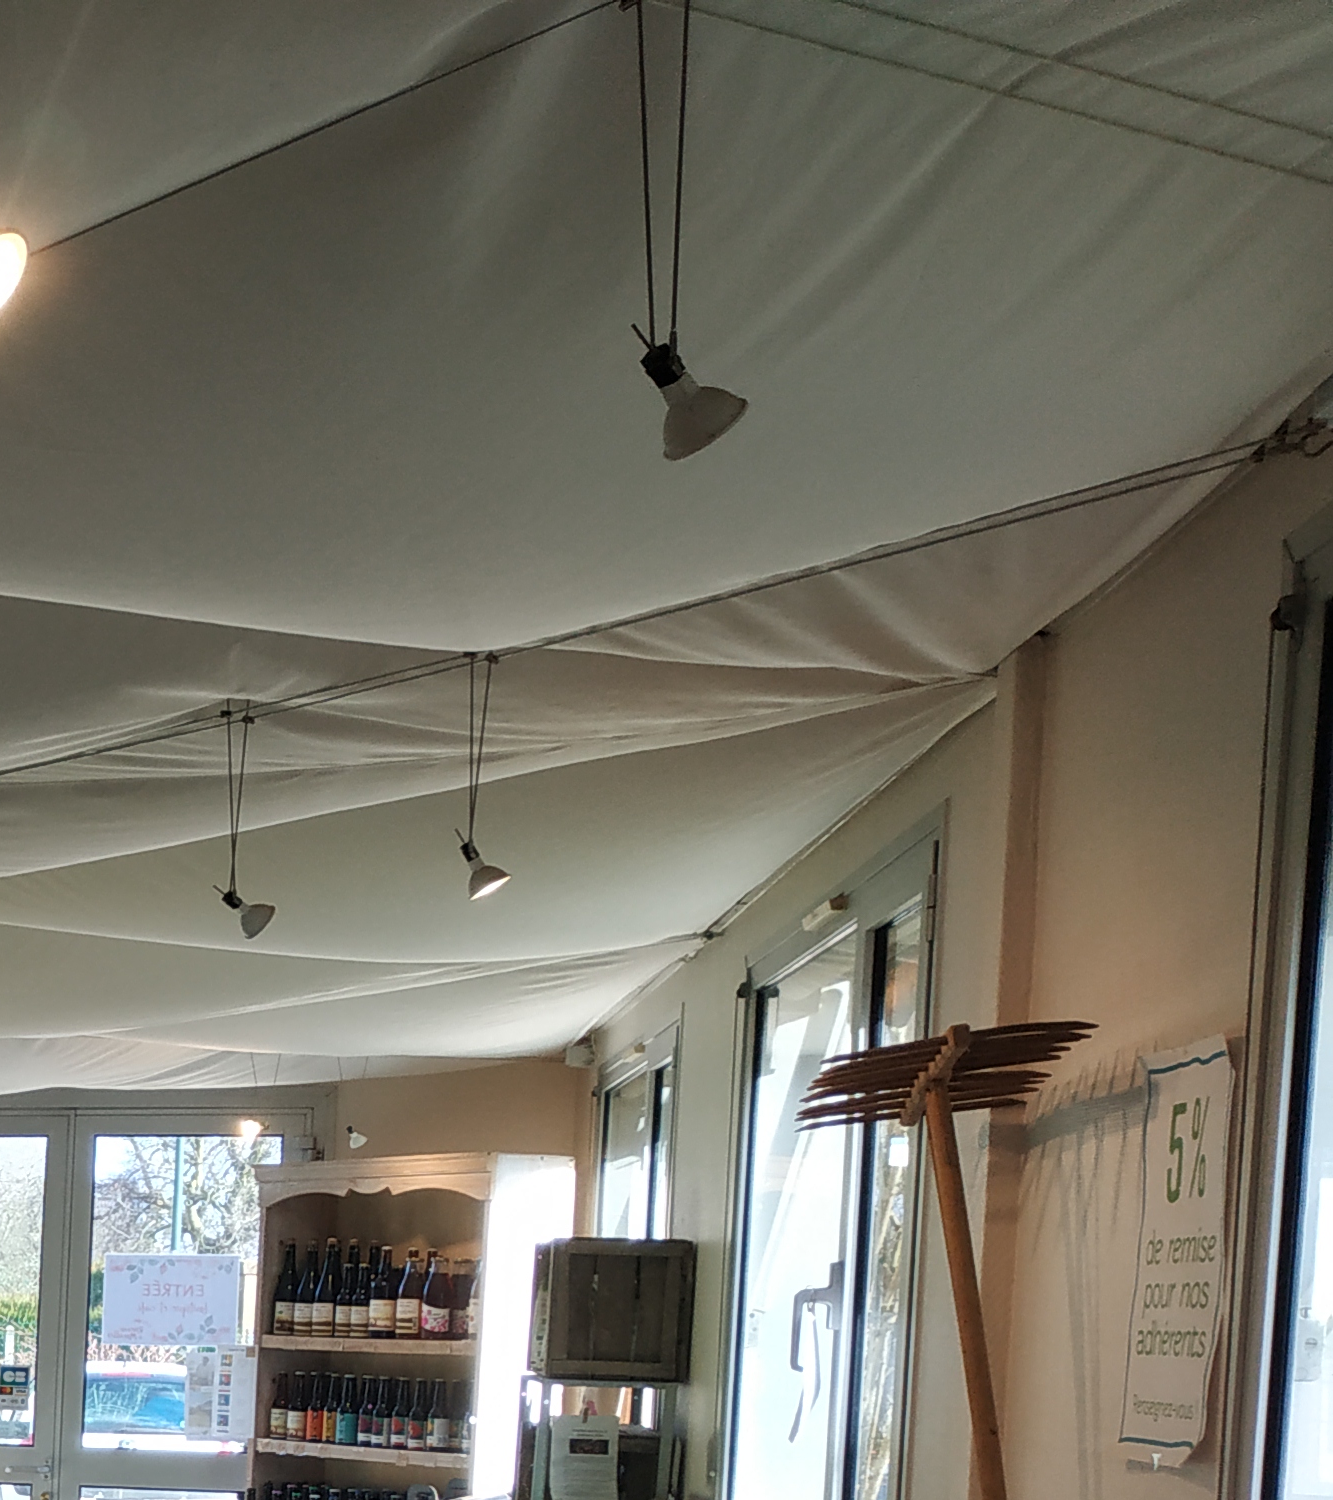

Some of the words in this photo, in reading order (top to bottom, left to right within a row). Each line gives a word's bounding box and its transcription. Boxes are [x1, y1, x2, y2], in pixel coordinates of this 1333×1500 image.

[1165, 1096, 1211, 1205] 5%
[1146, 1229, 1164, 1266] de
[1167, 1226, 1217, 1264] remise
[1141, 1282, 1176, 1320] pour
[1179, 1279, 1210, 1310] nos
[1135, 1319, 1207, 1359] adhérents
